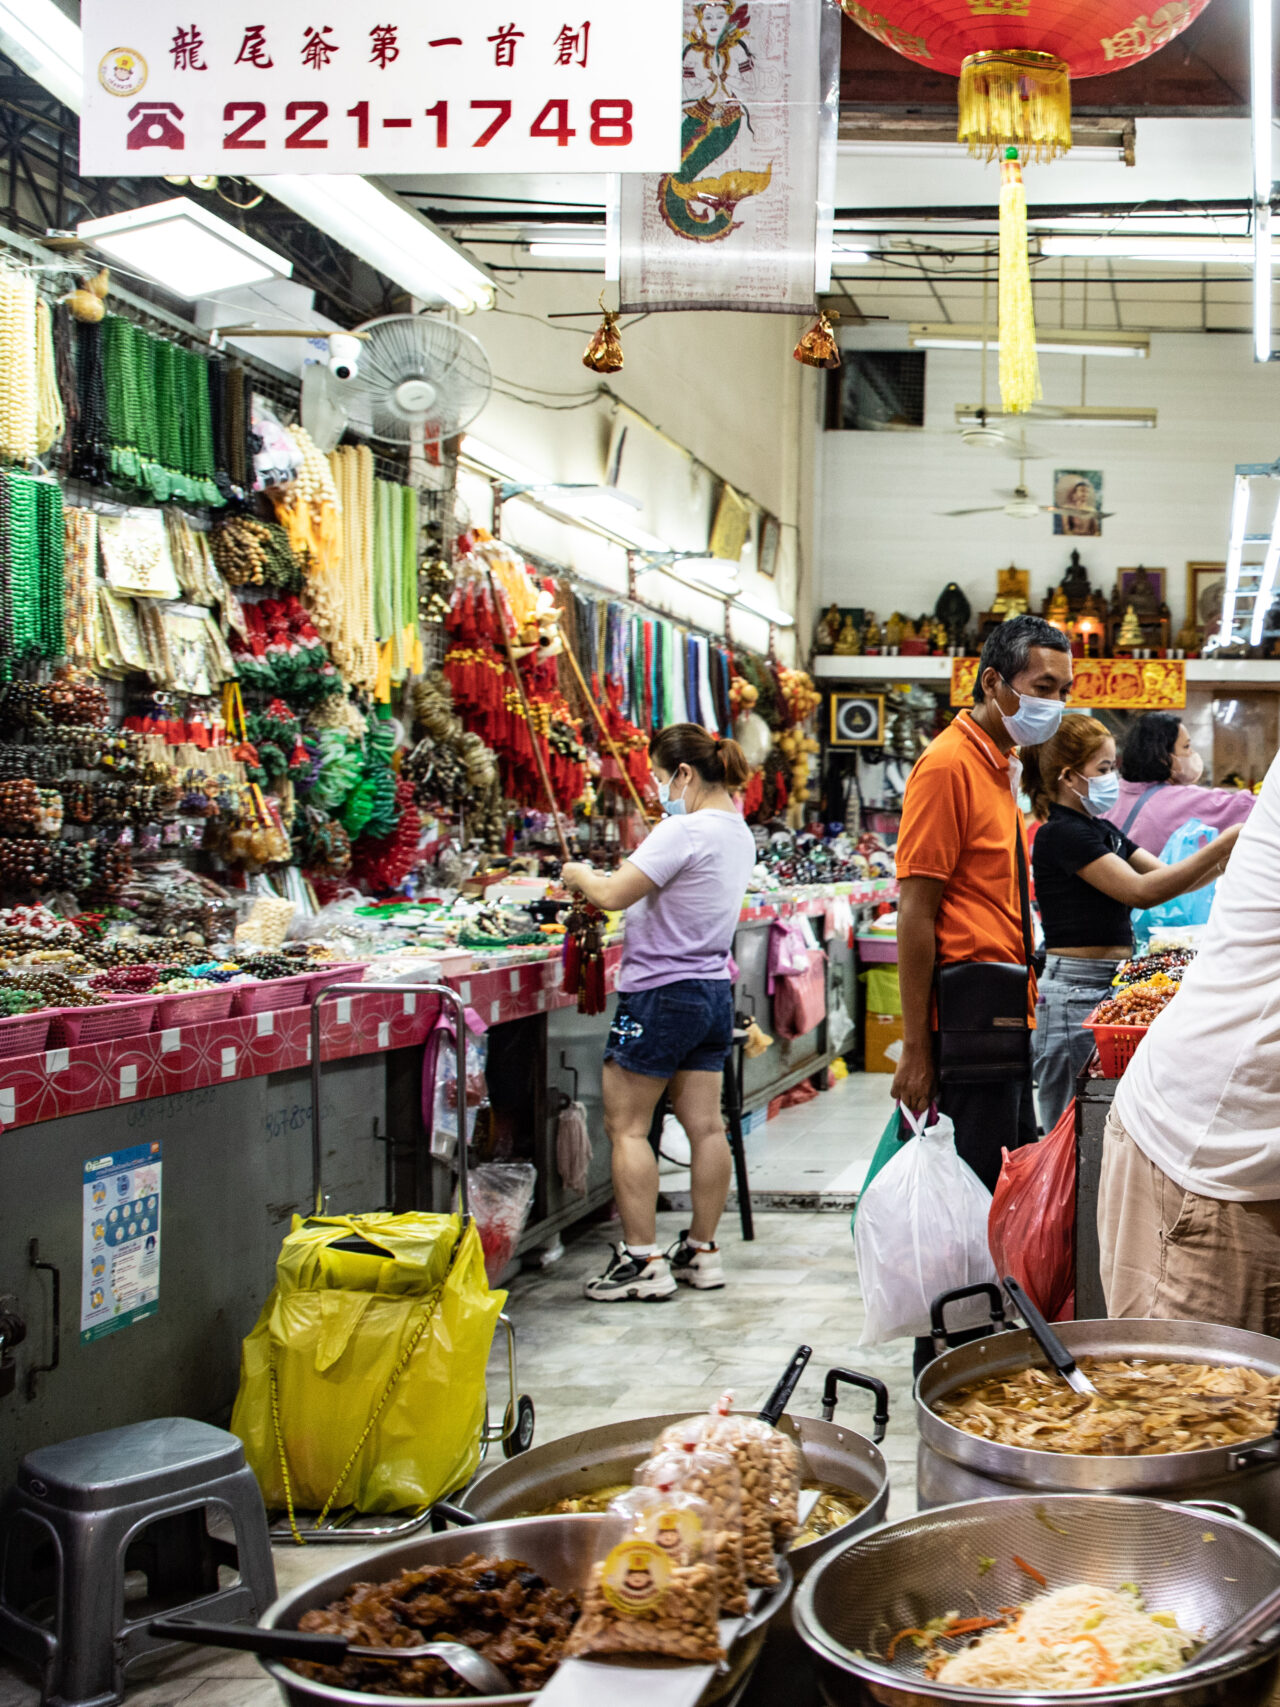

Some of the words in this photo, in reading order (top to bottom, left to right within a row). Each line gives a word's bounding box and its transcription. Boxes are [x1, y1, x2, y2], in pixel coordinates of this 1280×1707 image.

[169, 21, 592, 72] 龍尾爺第一首創
[222, 98, 634, 150] 221-1748
